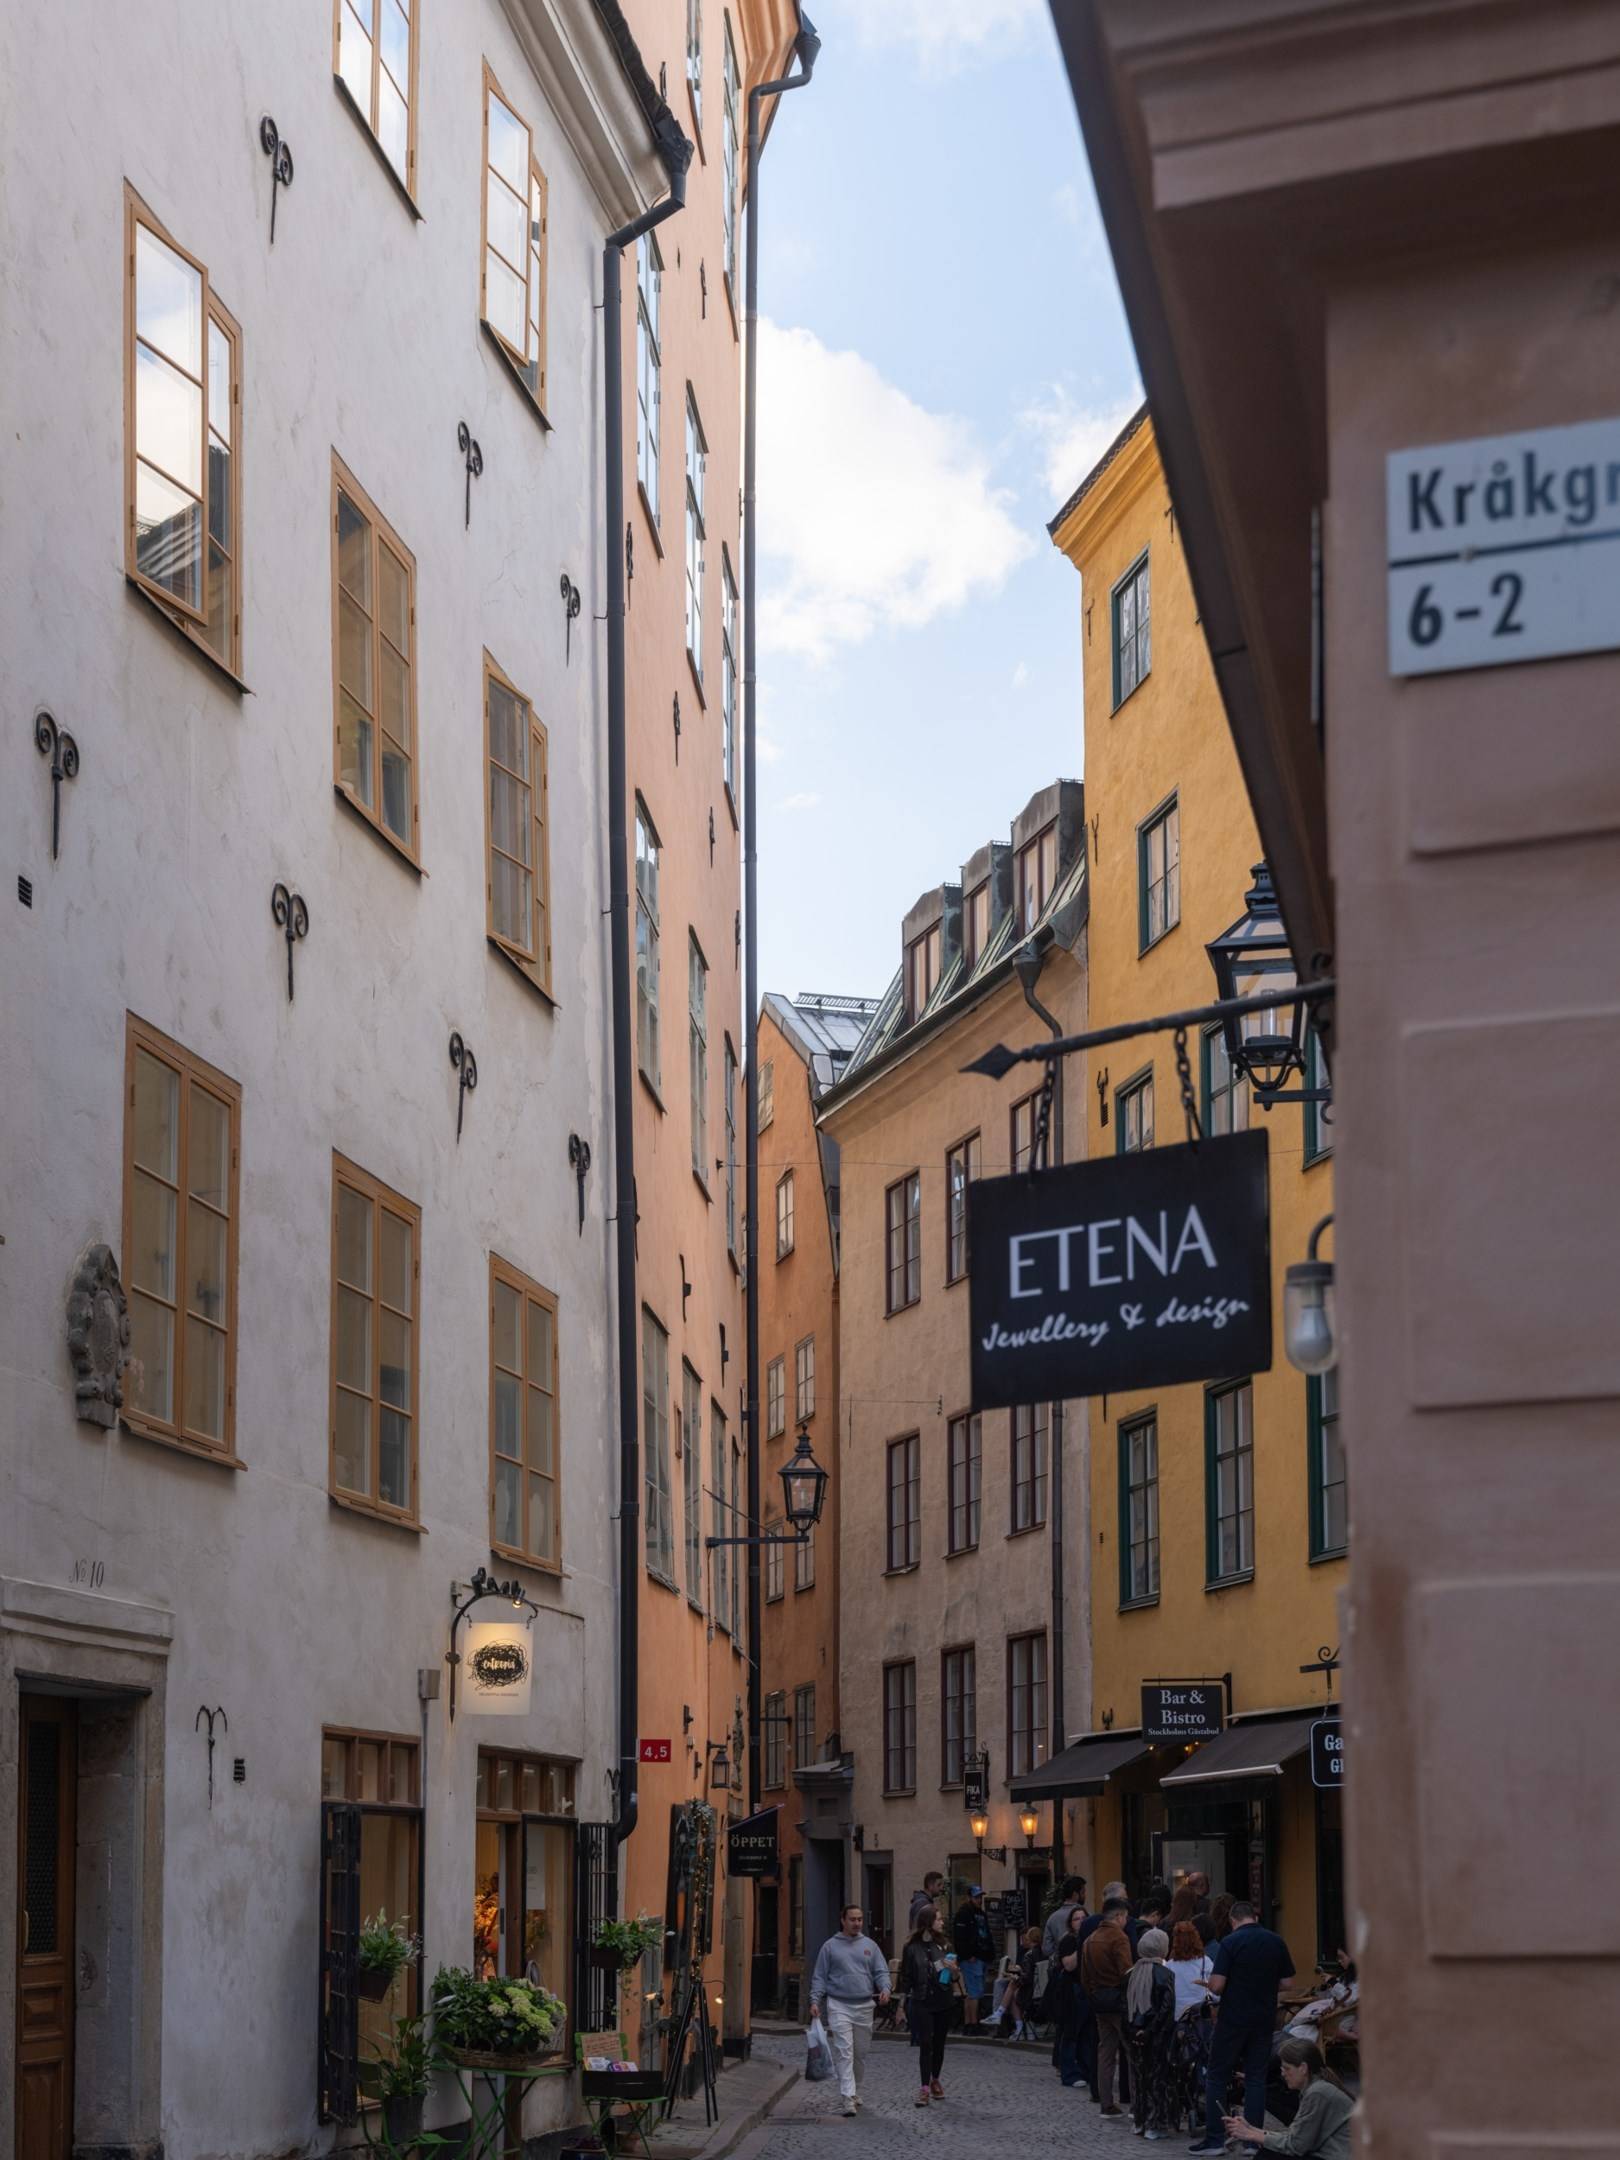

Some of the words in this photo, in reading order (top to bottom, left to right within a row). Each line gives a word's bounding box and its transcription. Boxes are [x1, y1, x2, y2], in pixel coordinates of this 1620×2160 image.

[1408, 571, 1525, 648] 6-2
[1009, 1203, 1218, 1299] ETENA
[982, 1312, 1109, 1351] Jewellery
[1119, 1303, 1146, 1331] &
[1155, 1296, 1250, 1330] design
[90, 1560, 105, 1588] 10
[1160, 1689, 1187, 1705] Bar
[1189, 1689, 1206, 1705] &
[1161, 1709, 1206, 1725] Bistro
[966, 1785, 981, 1795] FIKA
[730, 1834, 775, 1848] ÖPPET
